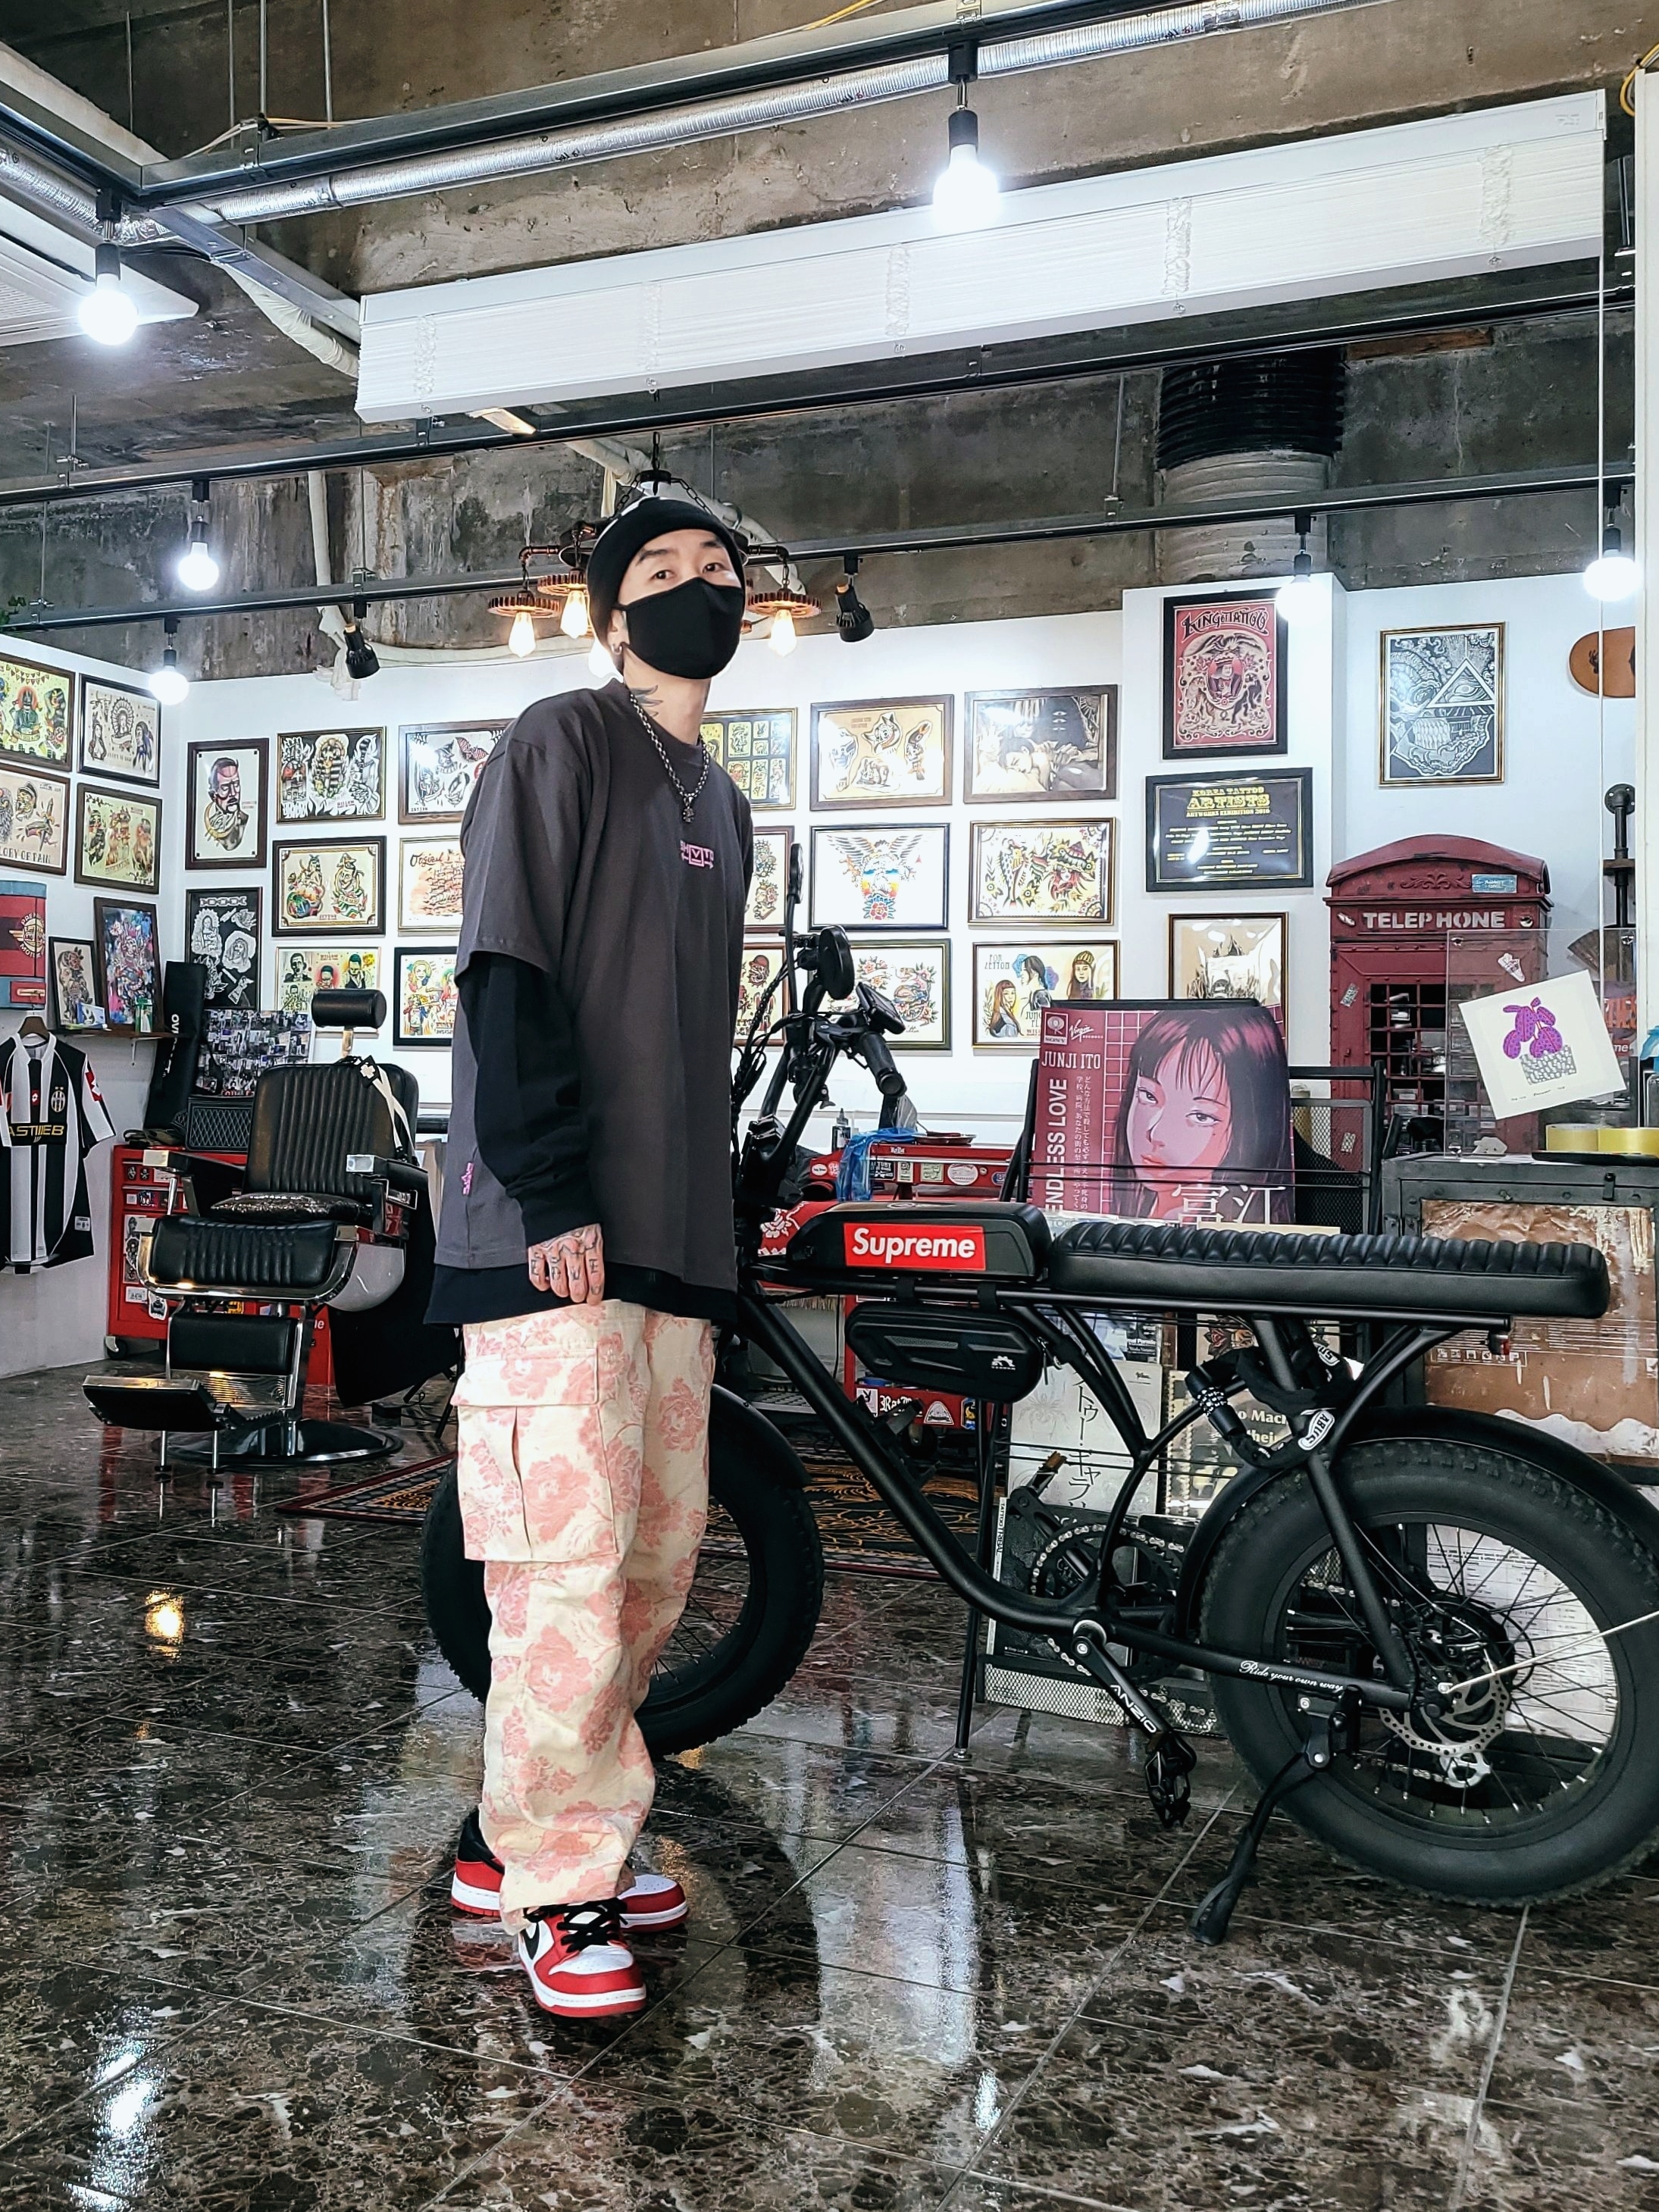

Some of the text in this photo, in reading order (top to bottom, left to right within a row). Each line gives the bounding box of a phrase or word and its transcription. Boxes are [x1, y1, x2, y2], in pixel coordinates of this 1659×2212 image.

[1186, 793, 1271, 810] ARTISTS
[1226, 786, 1265, 795] TATTOO
[21, 850, 31, 860] OF
[33, 852, 51, 864] PAIN
[1363, 911, 1505, 929] TELEPHONE
[1069, 1019, 1094, 1043] Virgin
[1041, 1050, 1101, 1070] JUNJI ITO
[1044, 1078, 1067, 1213] ENDLESS LOVE
[852, 1227, 976, 1264] Supreme
[1306, 1413, 1331, 1444] ABUS
[1238, 1660, 1344, 1694] Ride your own way
[1110, 1684, 1157, 1733] ANZIO
